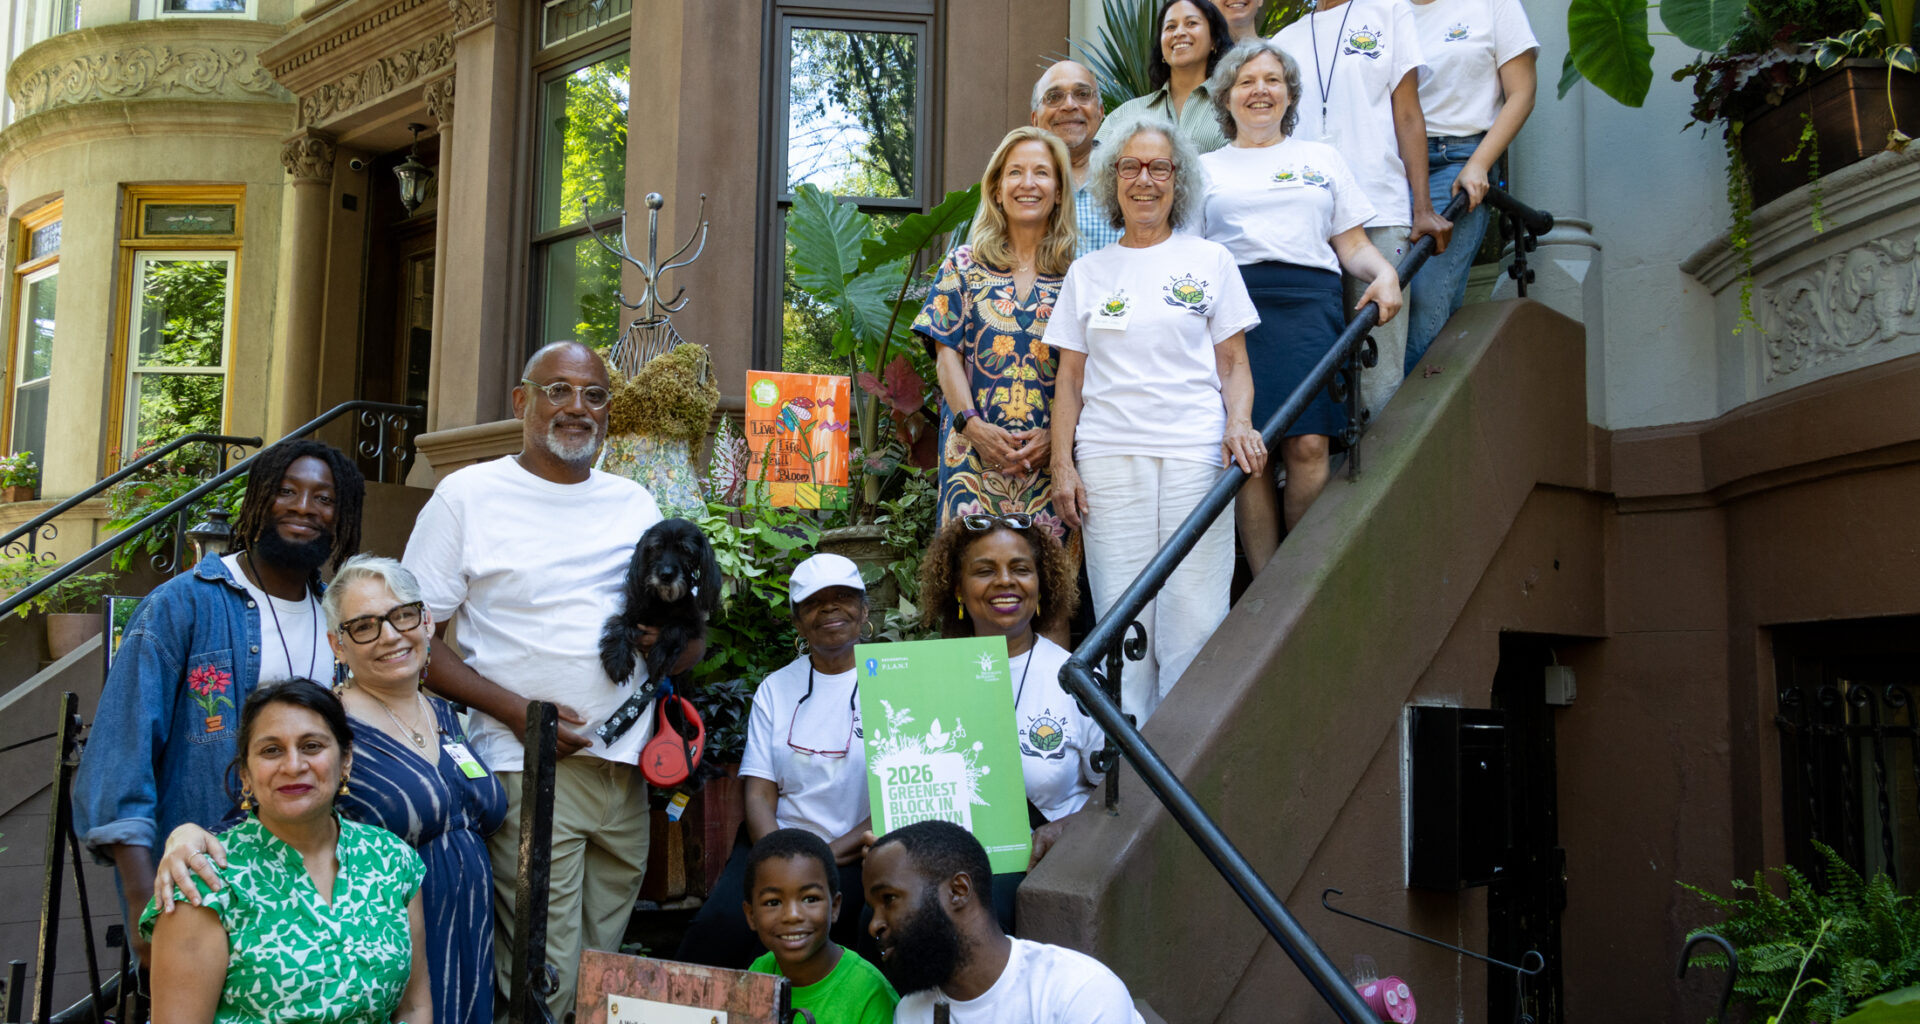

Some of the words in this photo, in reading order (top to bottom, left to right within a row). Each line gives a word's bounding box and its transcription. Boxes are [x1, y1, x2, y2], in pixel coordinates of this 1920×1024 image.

[751, 421, 775, 435] Live
[887, 764, 933, 786] 2026
[888, 782, 958, 801] GREENEST
[889, 799, 935, 815] BLOCK
[938, 797, 954, 811] IN
